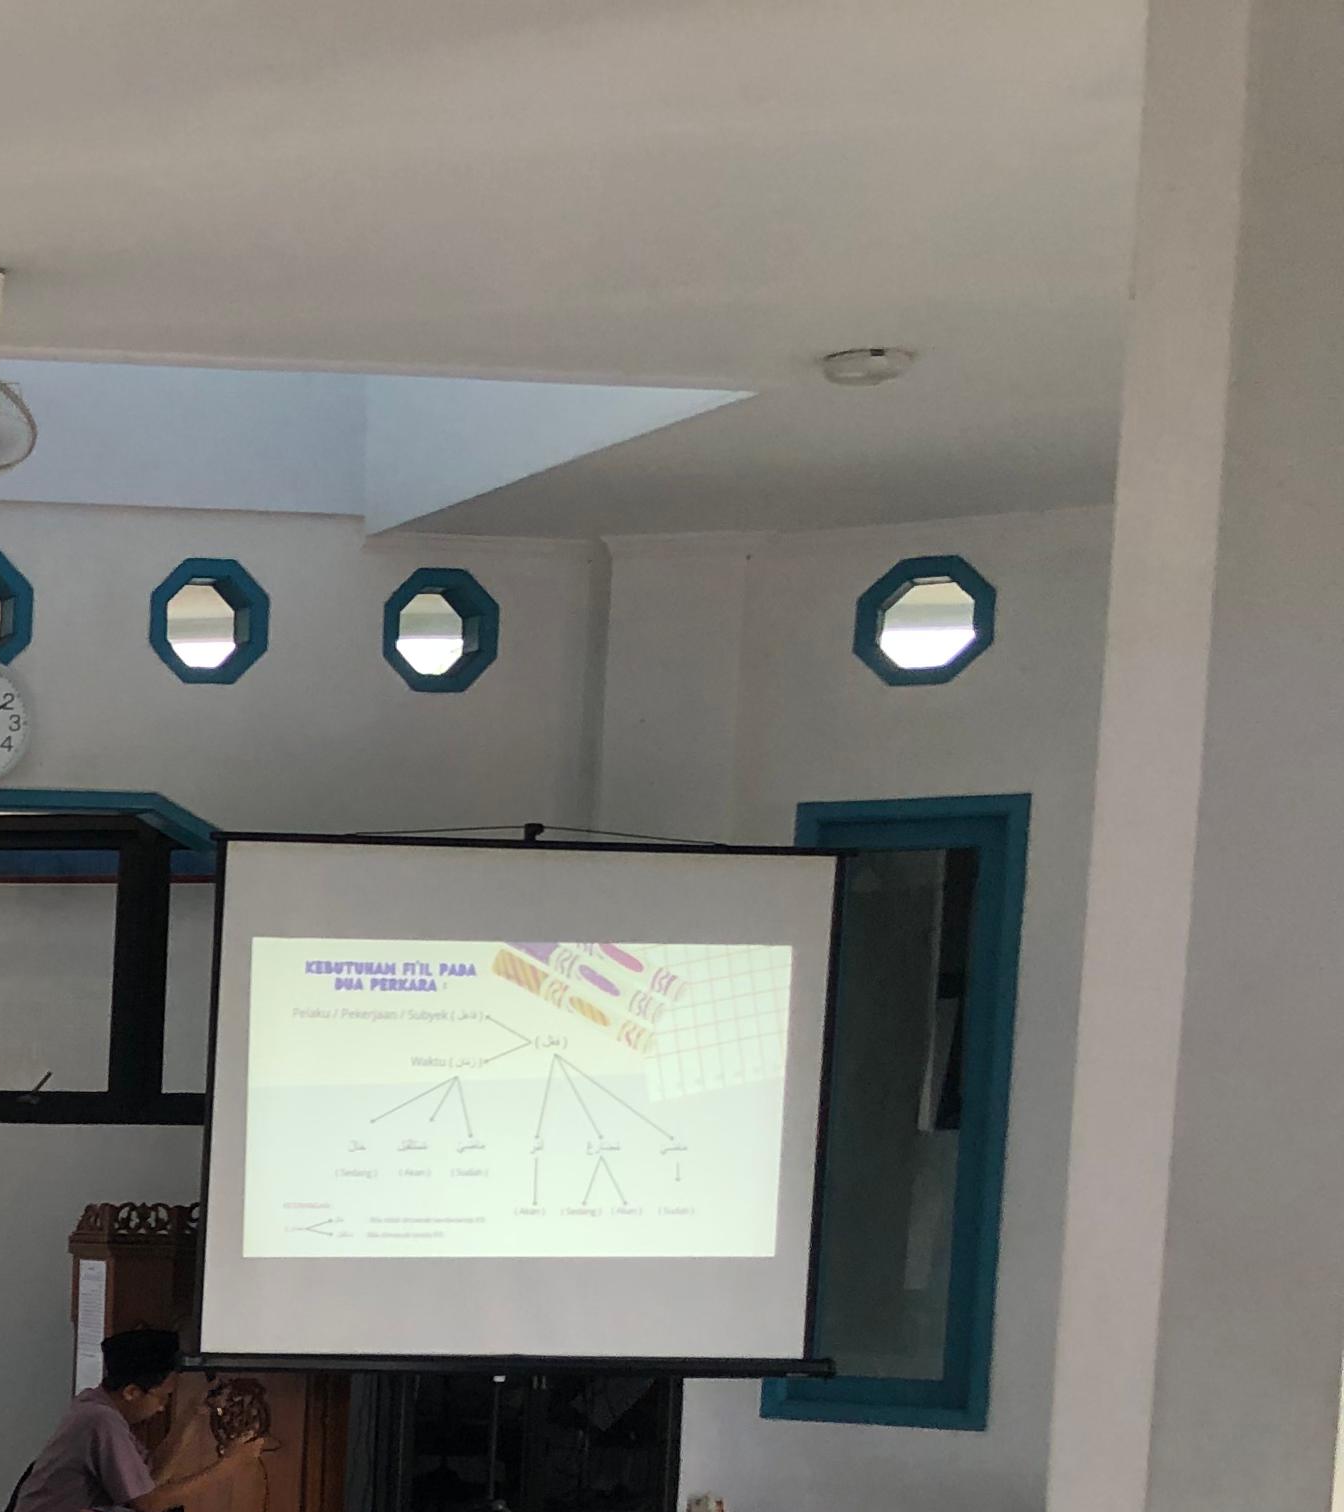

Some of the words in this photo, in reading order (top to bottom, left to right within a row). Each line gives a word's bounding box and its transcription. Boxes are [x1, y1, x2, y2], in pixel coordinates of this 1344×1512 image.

[3, 693, 15, 710] 2
[9, 714, 21, 732] 3
[0, 735, 14, 752] 4
[439, 962, 477, 977] PADA
[335, 977, 363, 991] DUA
[370, 978, 438, 992] PERKARA
